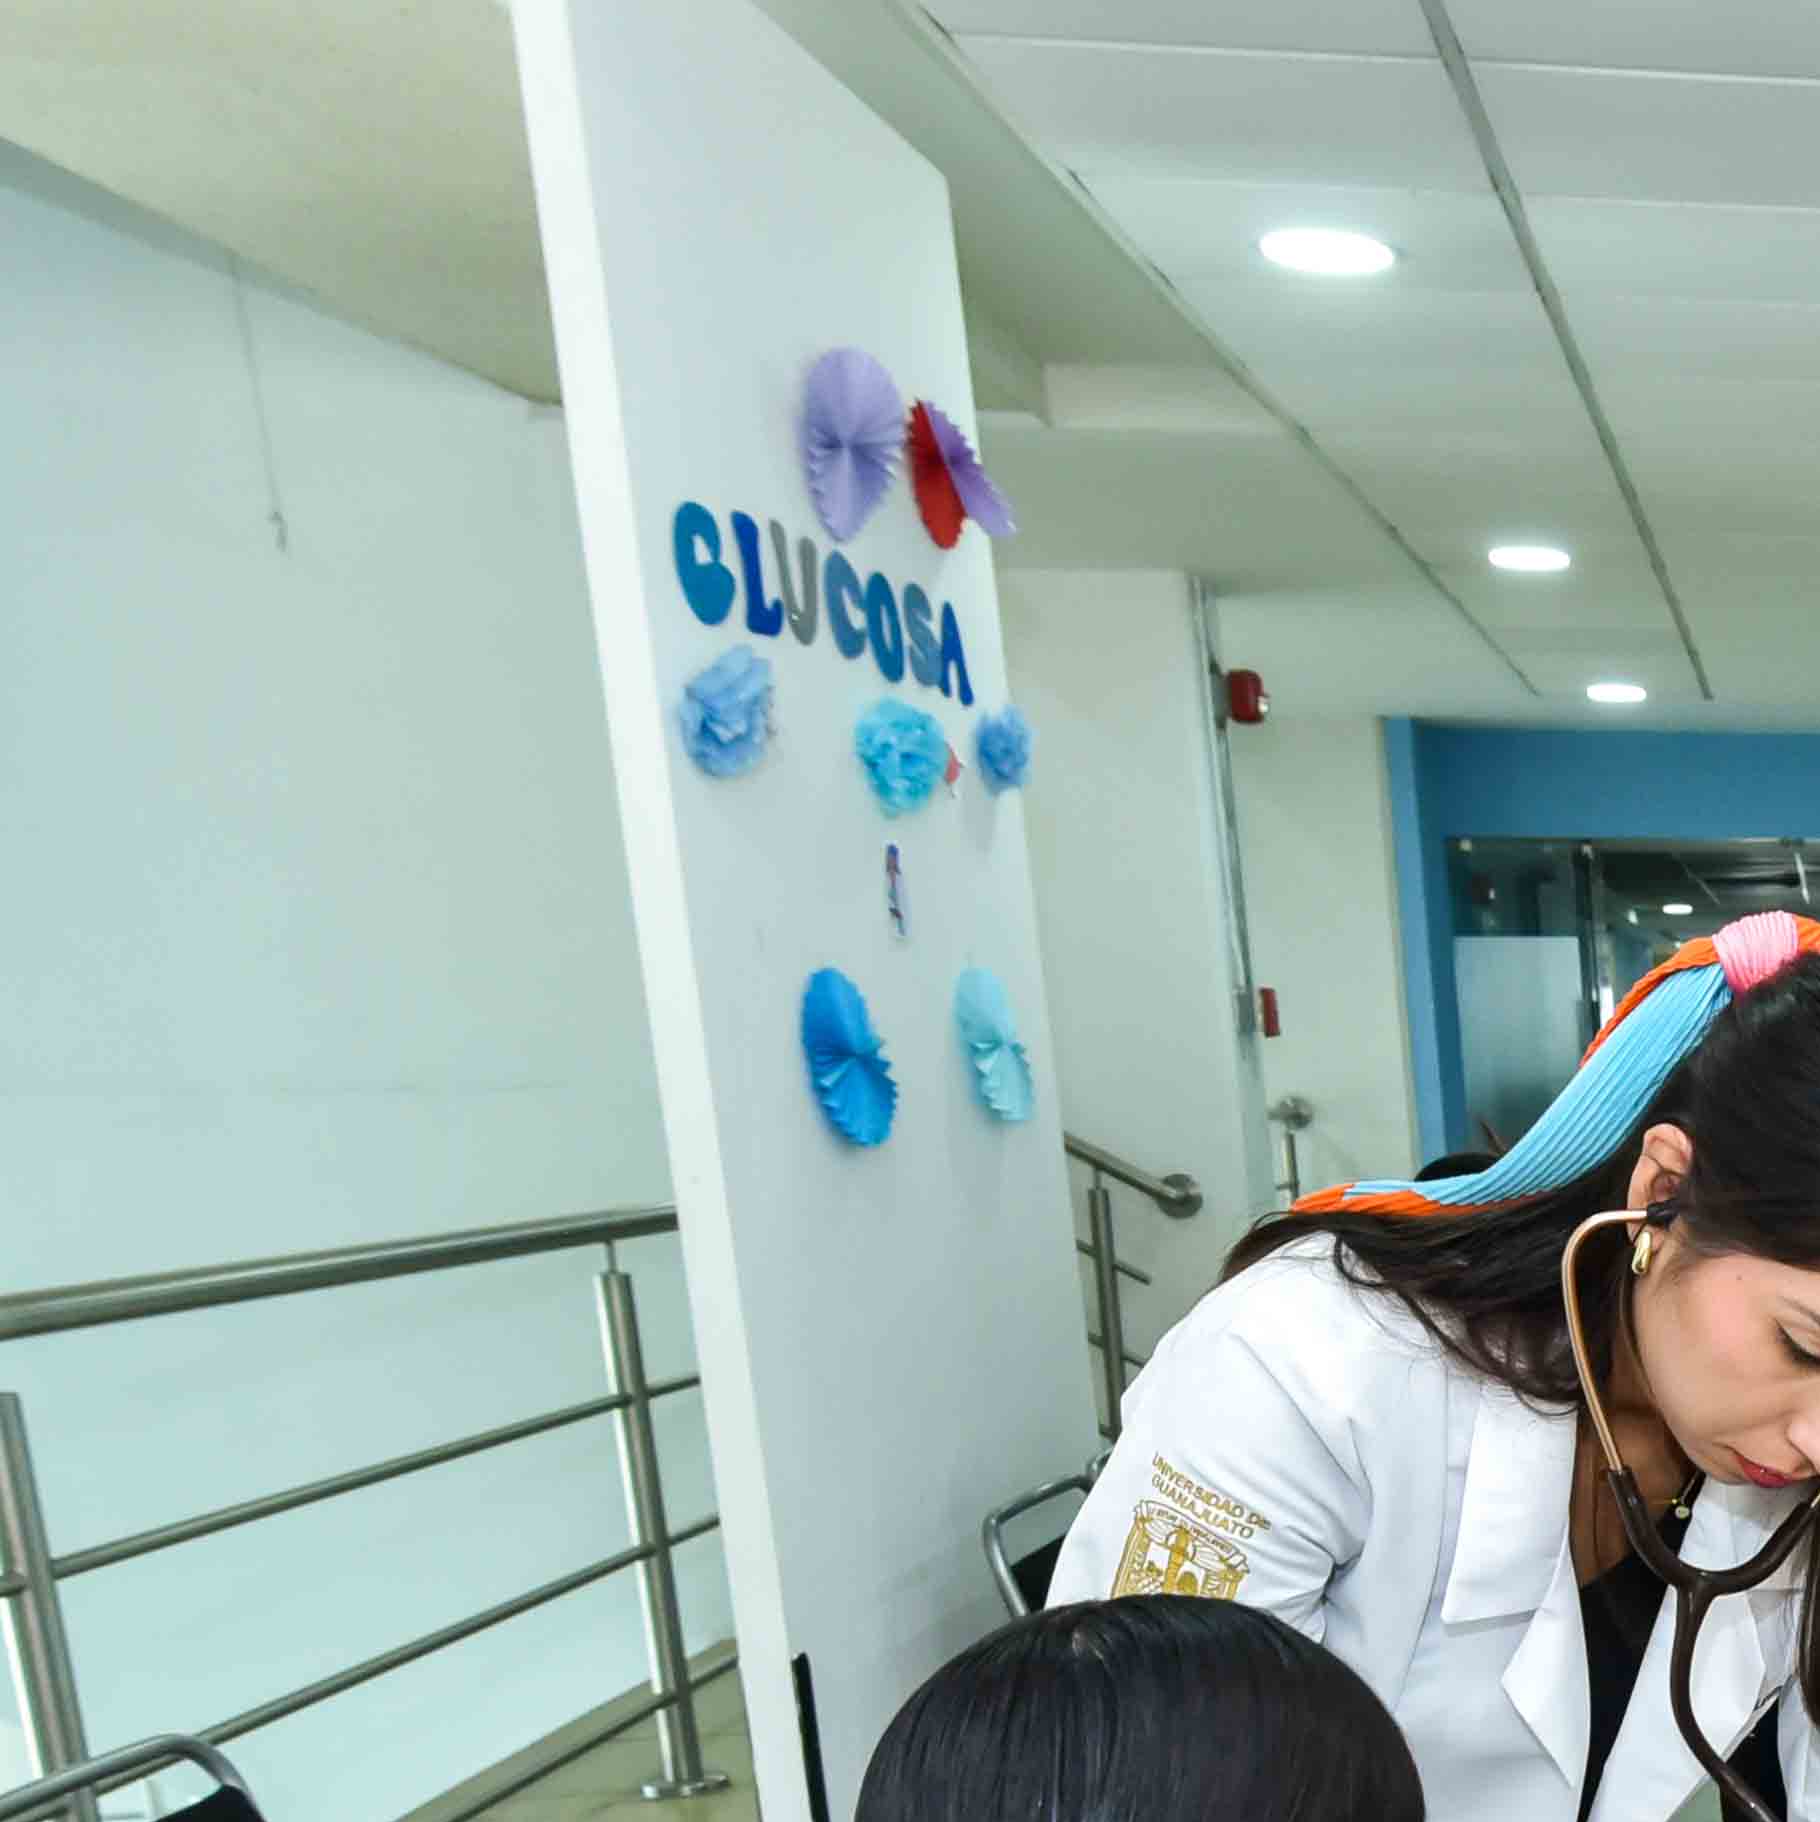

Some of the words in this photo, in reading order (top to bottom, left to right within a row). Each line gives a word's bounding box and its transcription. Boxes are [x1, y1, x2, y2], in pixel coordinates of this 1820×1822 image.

[673, 500, 974, 707] GLUCOSA
[1152, 1451, 1245, 1519] UNIVERSIDAD
[1152, 1473, 1255, 1539] GUANAJUATO
